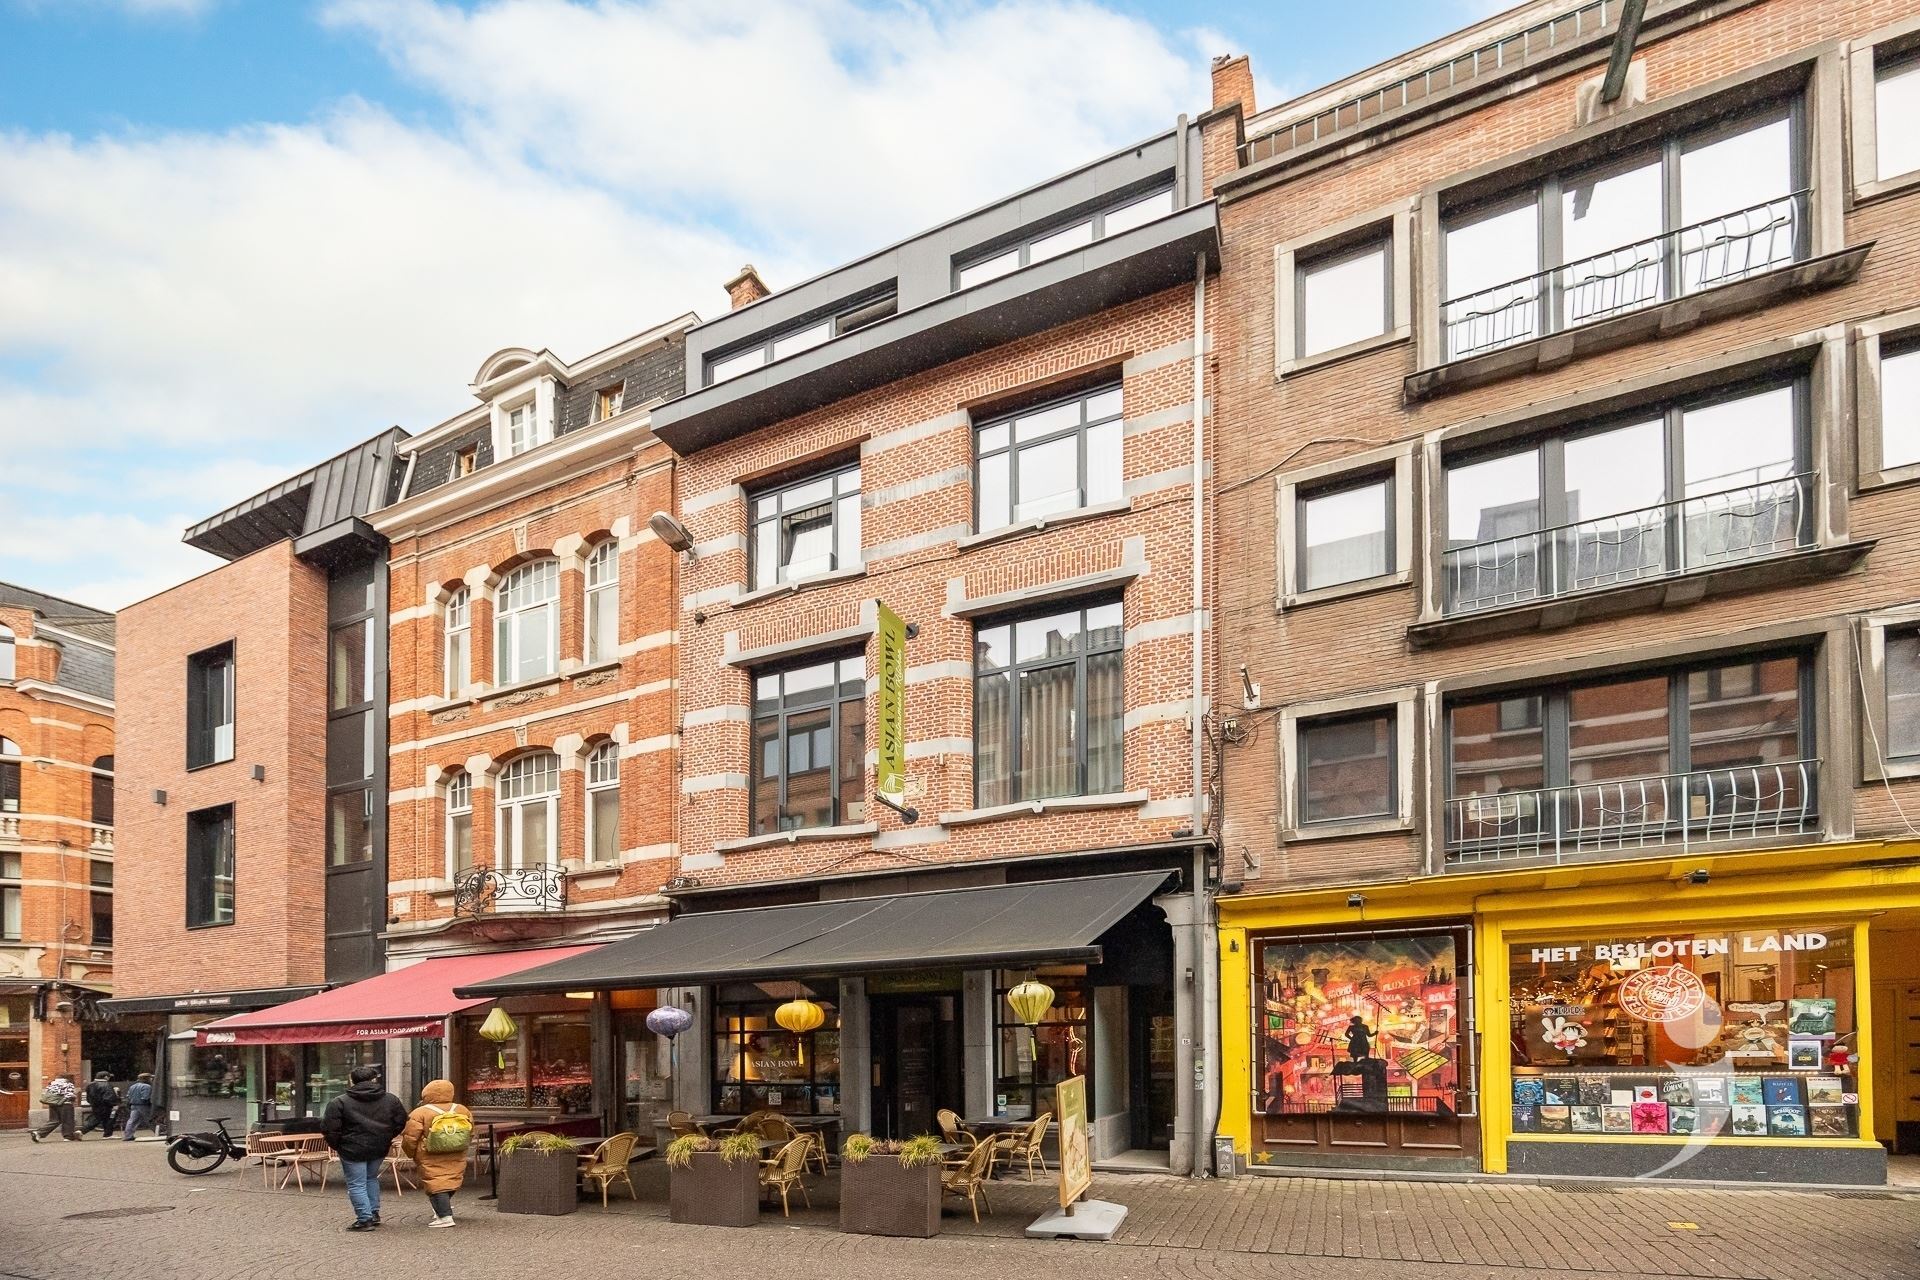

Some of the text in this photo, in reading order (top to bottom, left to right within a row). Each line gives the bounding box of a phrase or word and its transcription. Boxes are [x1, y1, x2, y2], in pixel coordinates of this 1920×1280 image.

[885, 630, 896, 770] ASIAN BOWL
[1531, 946, 1581, 963] HET
[1595, 938, 1728, 961] BESLOTEN
[1742, 933, 1828, 953] LAND
[1623, 995, 1698, 1020] BESLOTEN
